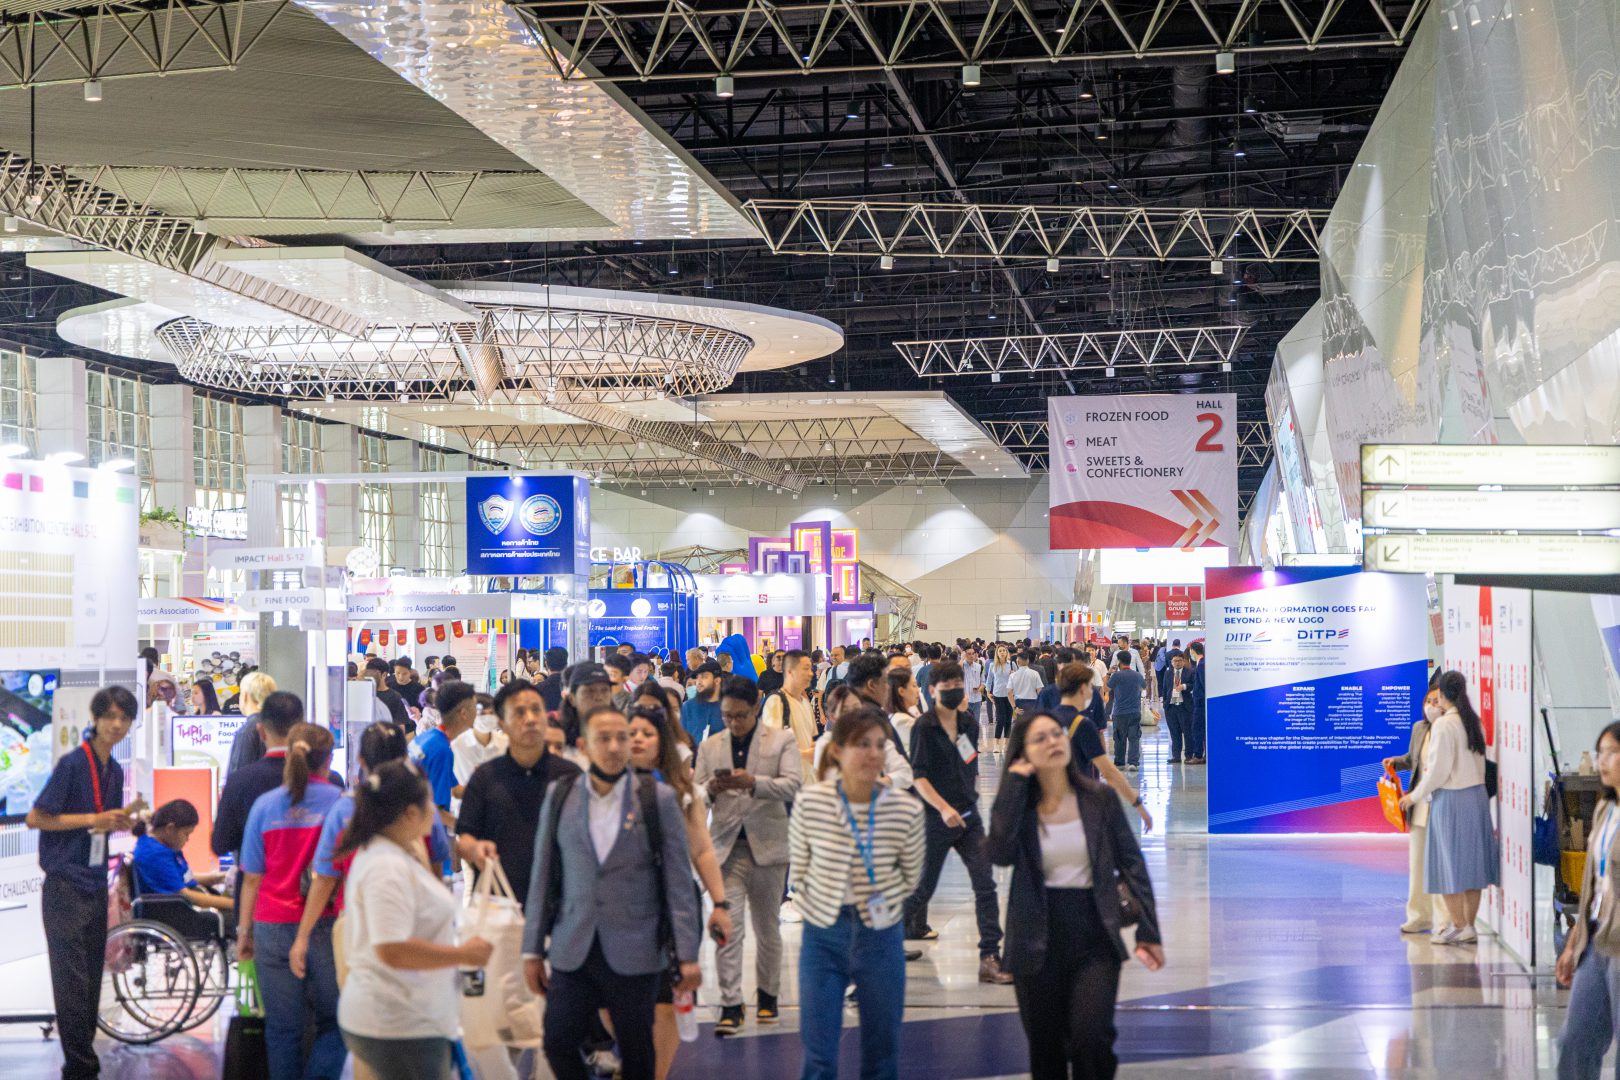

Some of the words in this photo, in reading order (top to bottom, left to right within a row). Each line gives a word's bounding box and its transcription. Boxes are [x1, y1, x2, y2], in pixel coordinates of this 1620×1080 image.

[1196, 400, 1222, 409] HALL
[1086, 412, 1131, 422] FROZEN
[1135, 411, 1169, 421] FOOD
[1195, 412, 1224, 452] 2
[1086, 437, 1117, 447] MEAT
[1086, 456, 1131, 466] SWEETS
[1134, 456, 1144, 466] &
[1086, 467, 1184, 478] CONFECTIONERY
[234, 555, 265, 563] IMPACT
[267, 554, 284, 562] Hall
[613, 546, 641, 562] BAR
[285, 596, 310, 604] FOOD
[159, 607, 200, 615] Association
[356, 605, 374, 613] Food
[415, 604, 456, 613] Association
[1223, 606, 1242, 614] THE
[1331, 605, 1356, 613] GOES
[1358, 605, 1377, 613] FAR
[1223, 616, 1262, 624] BEYOND
[1264, 616, 1271, 624] A
[1273, 616, 1296, 624] NEW
[1298, 616, 1325, 624] LOGO
[1225, 632, 1252, 642] DITP
